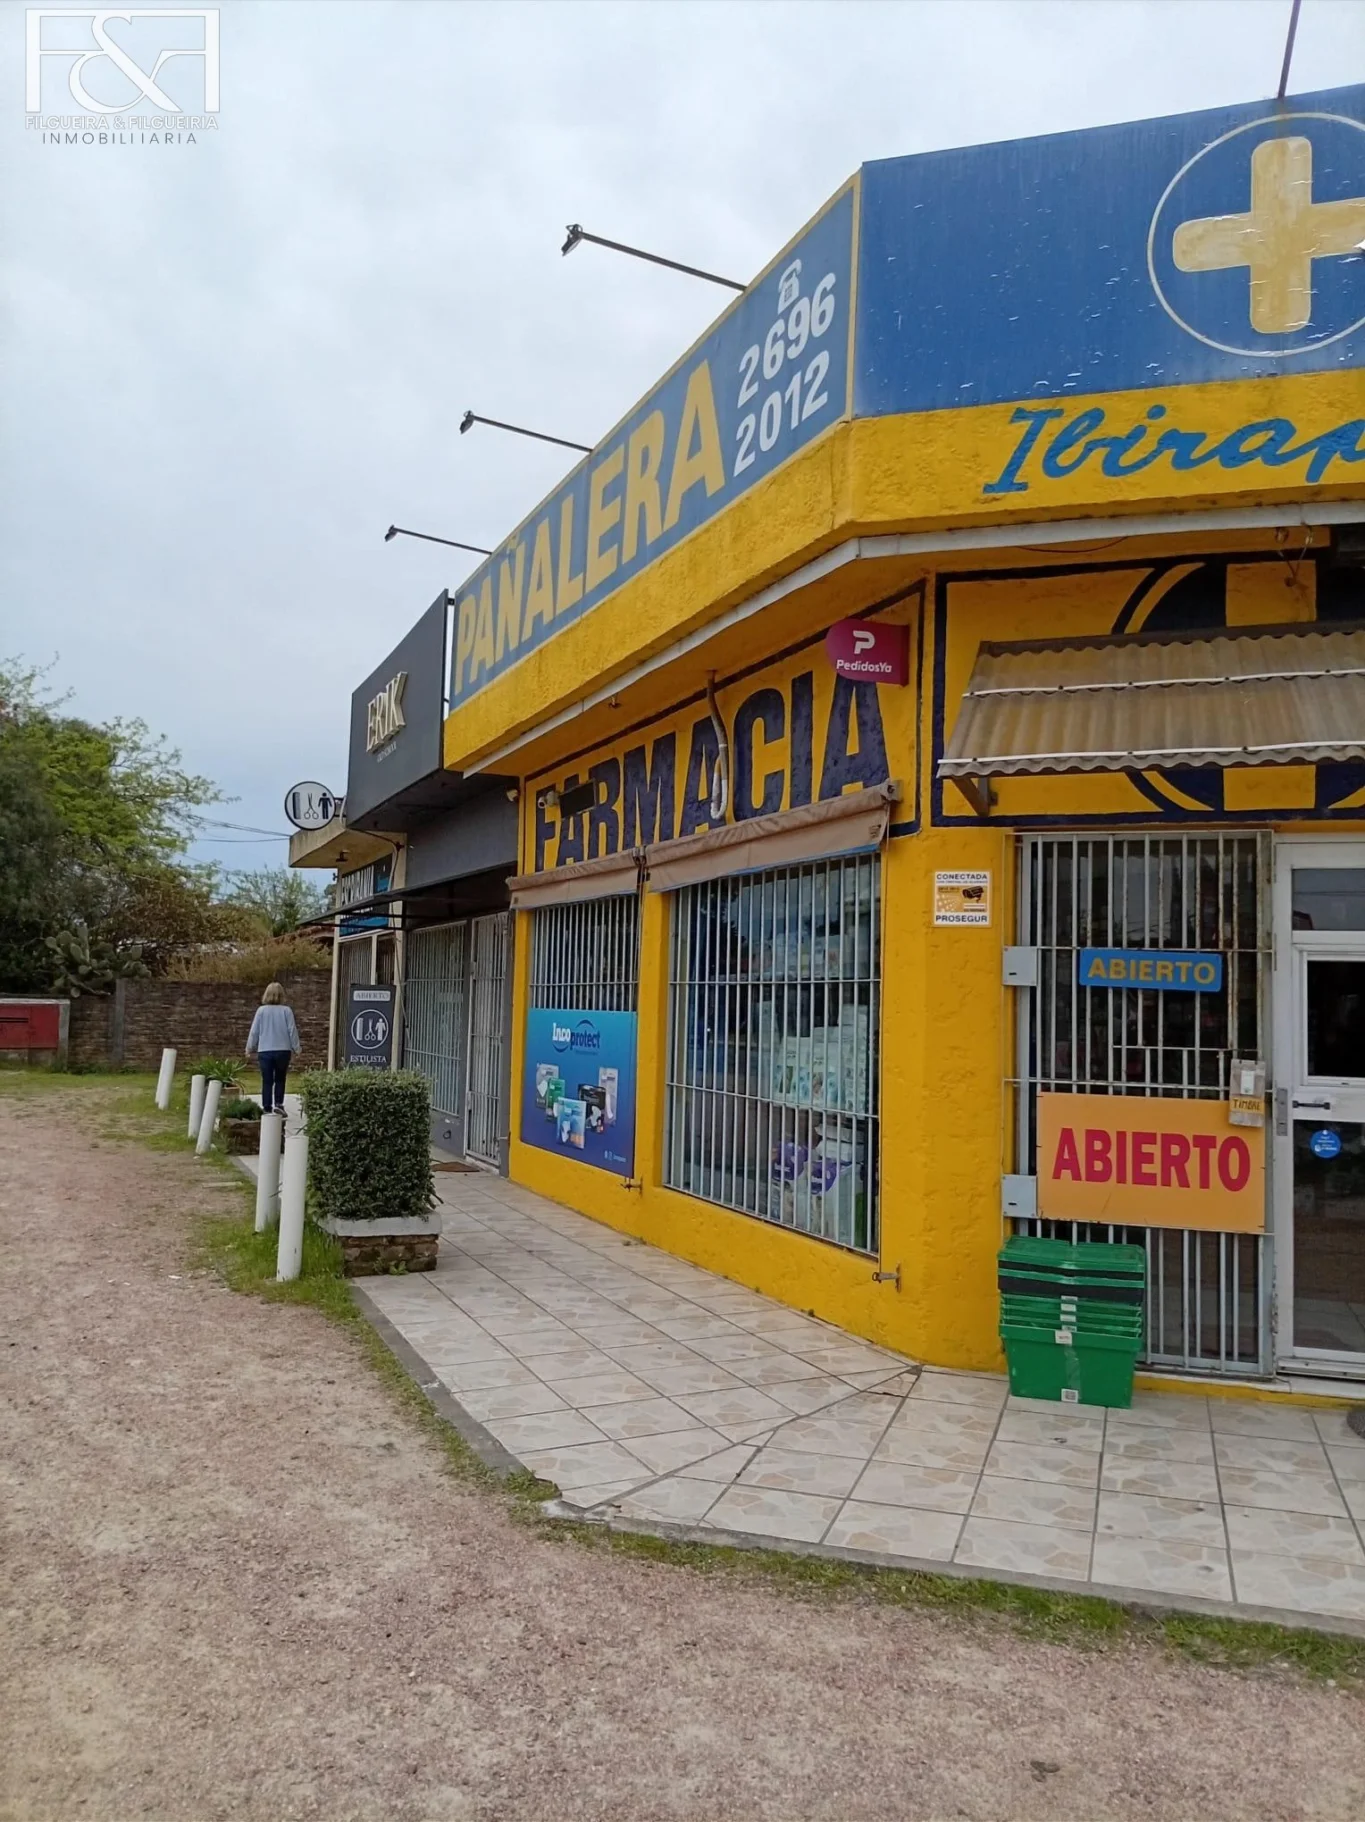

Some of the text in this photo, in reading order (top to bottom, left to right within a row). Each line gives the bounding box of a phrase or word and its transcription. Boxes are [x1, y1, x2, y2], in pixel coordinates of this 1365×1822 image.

[737, 272, 837, 409] 2696
[733, 350, 830, 478] 2012
[454, 358, 726, 697] PAÑALERA
[836, 659, 893, 673] PedidosYa
[366, 671, 408, 754] ERIK
[535, 670, 889, 873] FARMACIA
[935, 915, 988, 923] PROSEGUR
[1087, 957, 1216, 985] ABIERTO
[350, 1055, 387, 1063] ESTILISTA
[1052, 1127, 1250, 1192] ABIERTO
